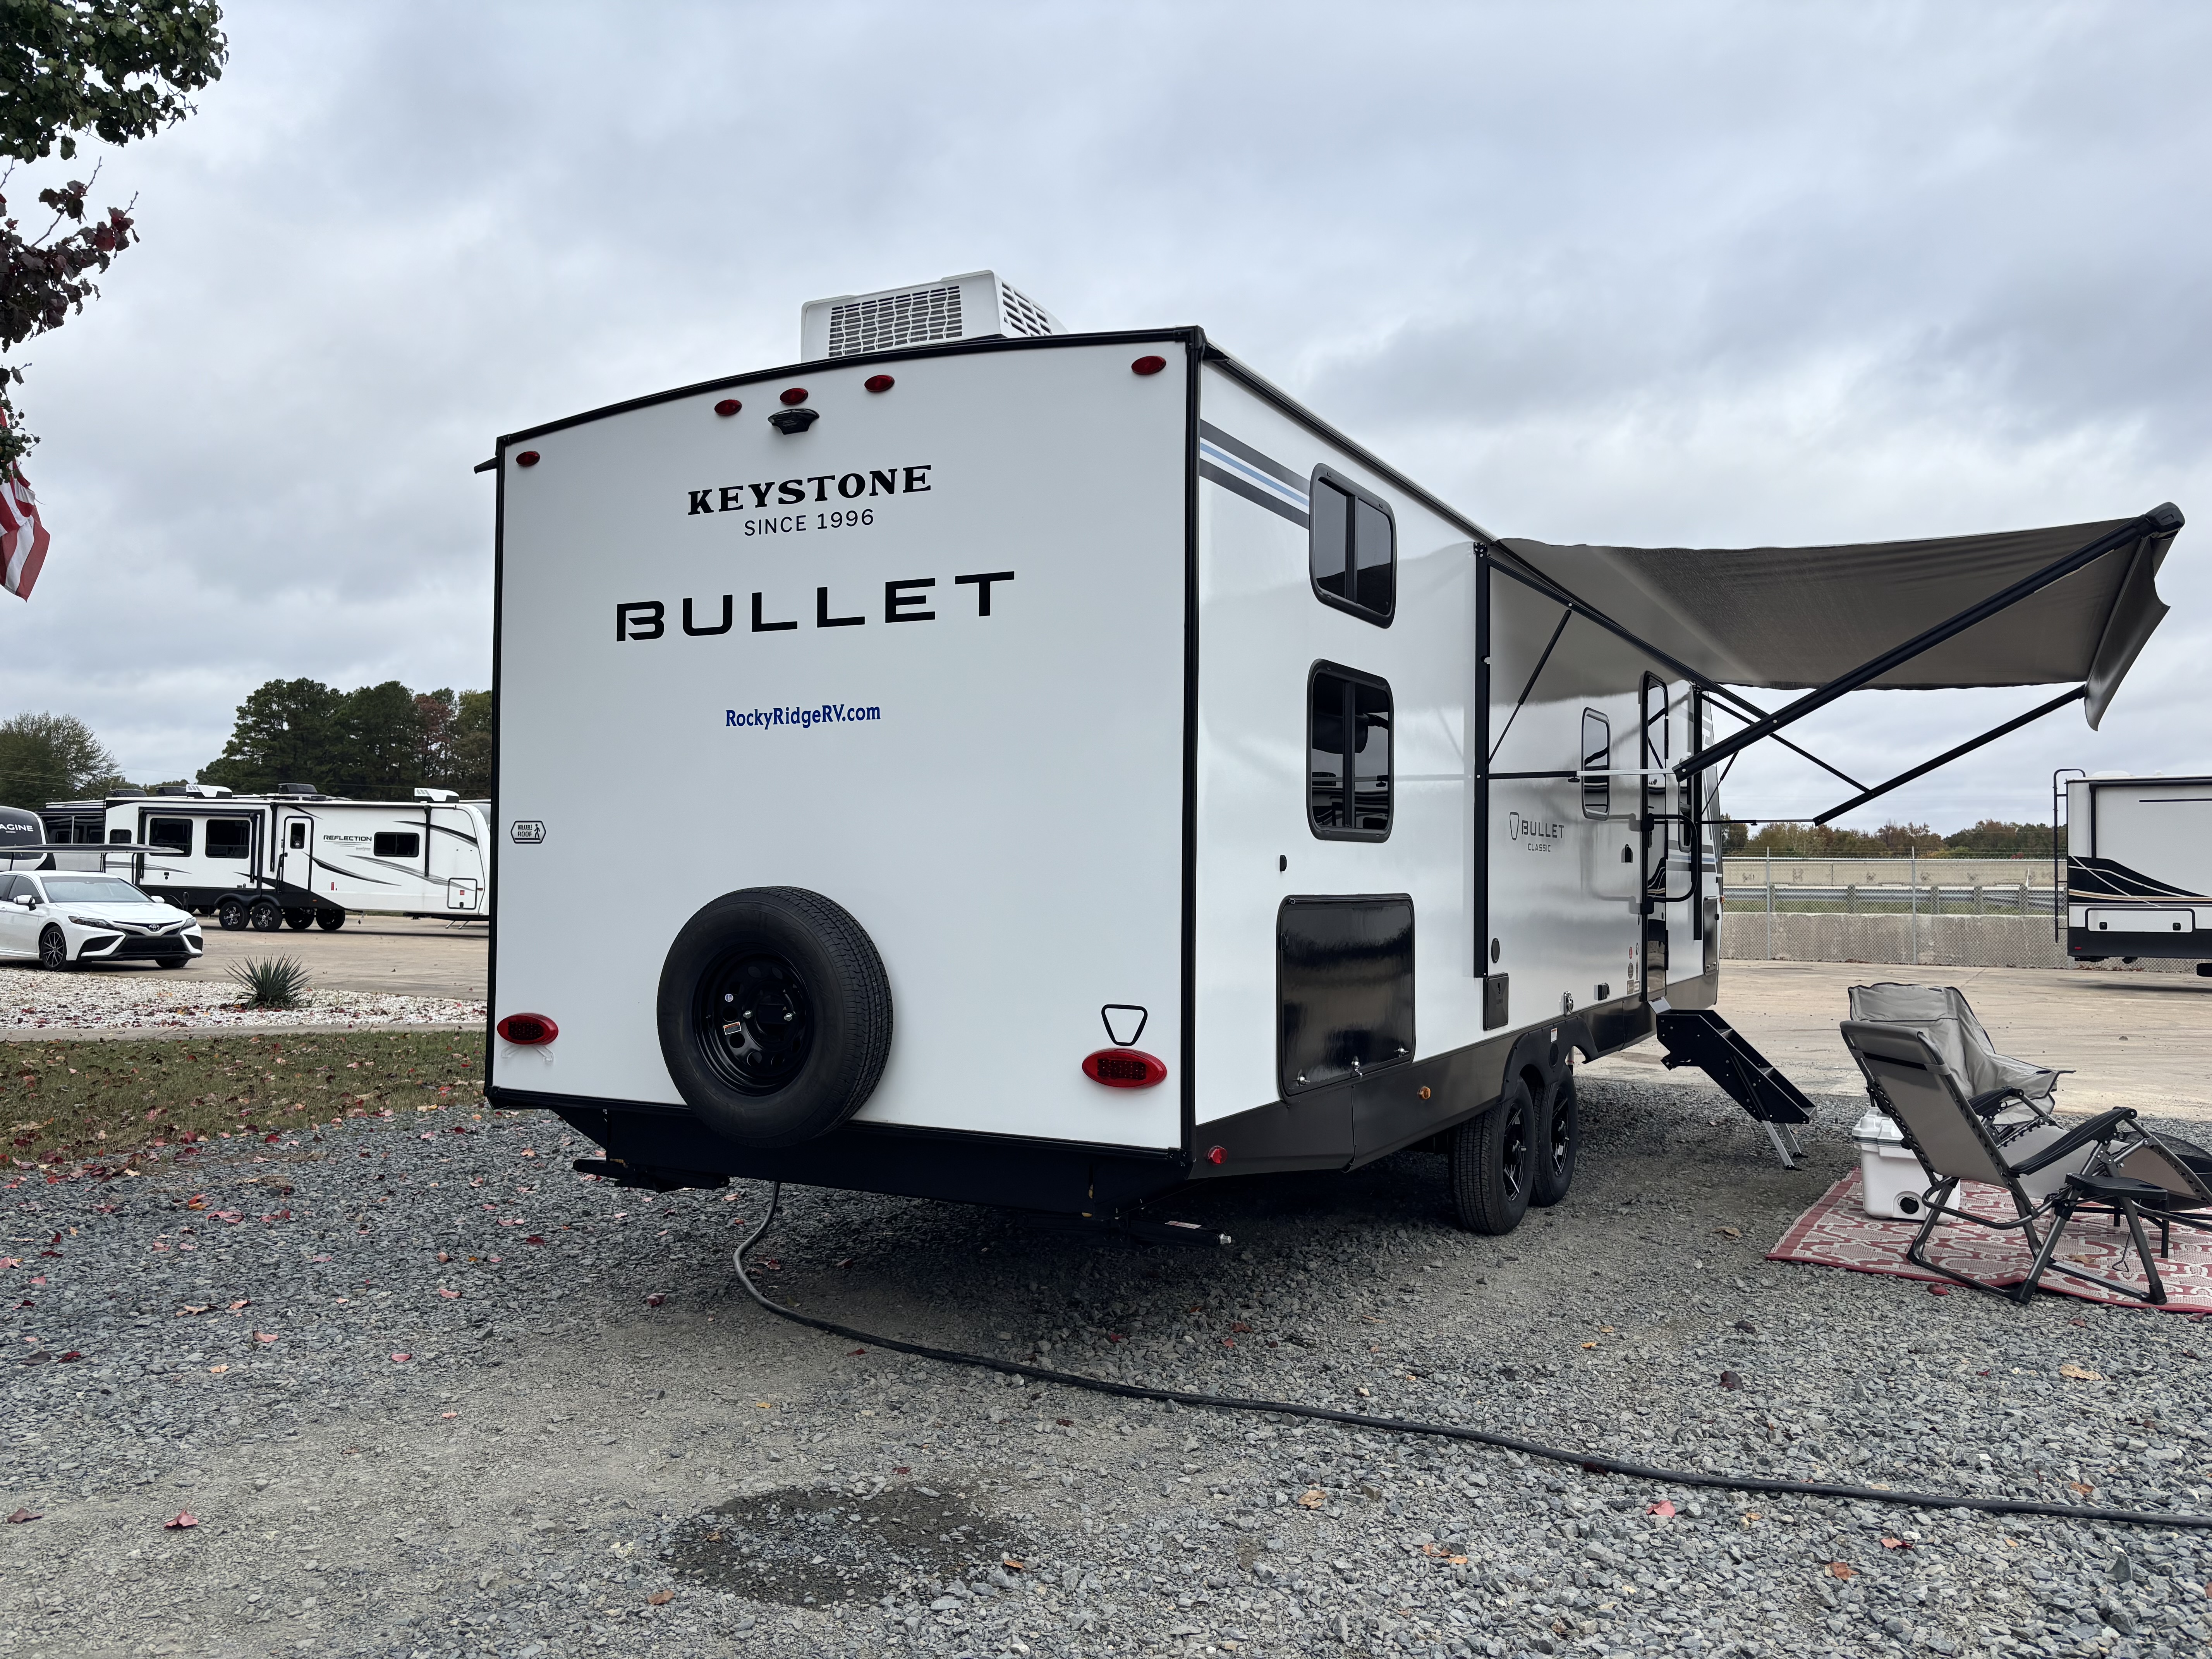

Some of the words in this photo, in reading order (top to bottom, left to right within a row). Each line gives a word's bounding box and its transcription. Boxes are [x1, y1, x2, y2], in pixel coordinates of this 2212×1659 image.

[688, 465, 931, 515] KEYSTONE
[744, 515, 807, 536] SINCE
[817, 508, 874, 530] 1996
[617, 571, 1015, 642] BULLET
[725, 704, 881, 730] RockyRidgeRV.com
[1522, 820, 1564, 839] BULLET
[1528, 843, 1551, 852] CLASSIC
